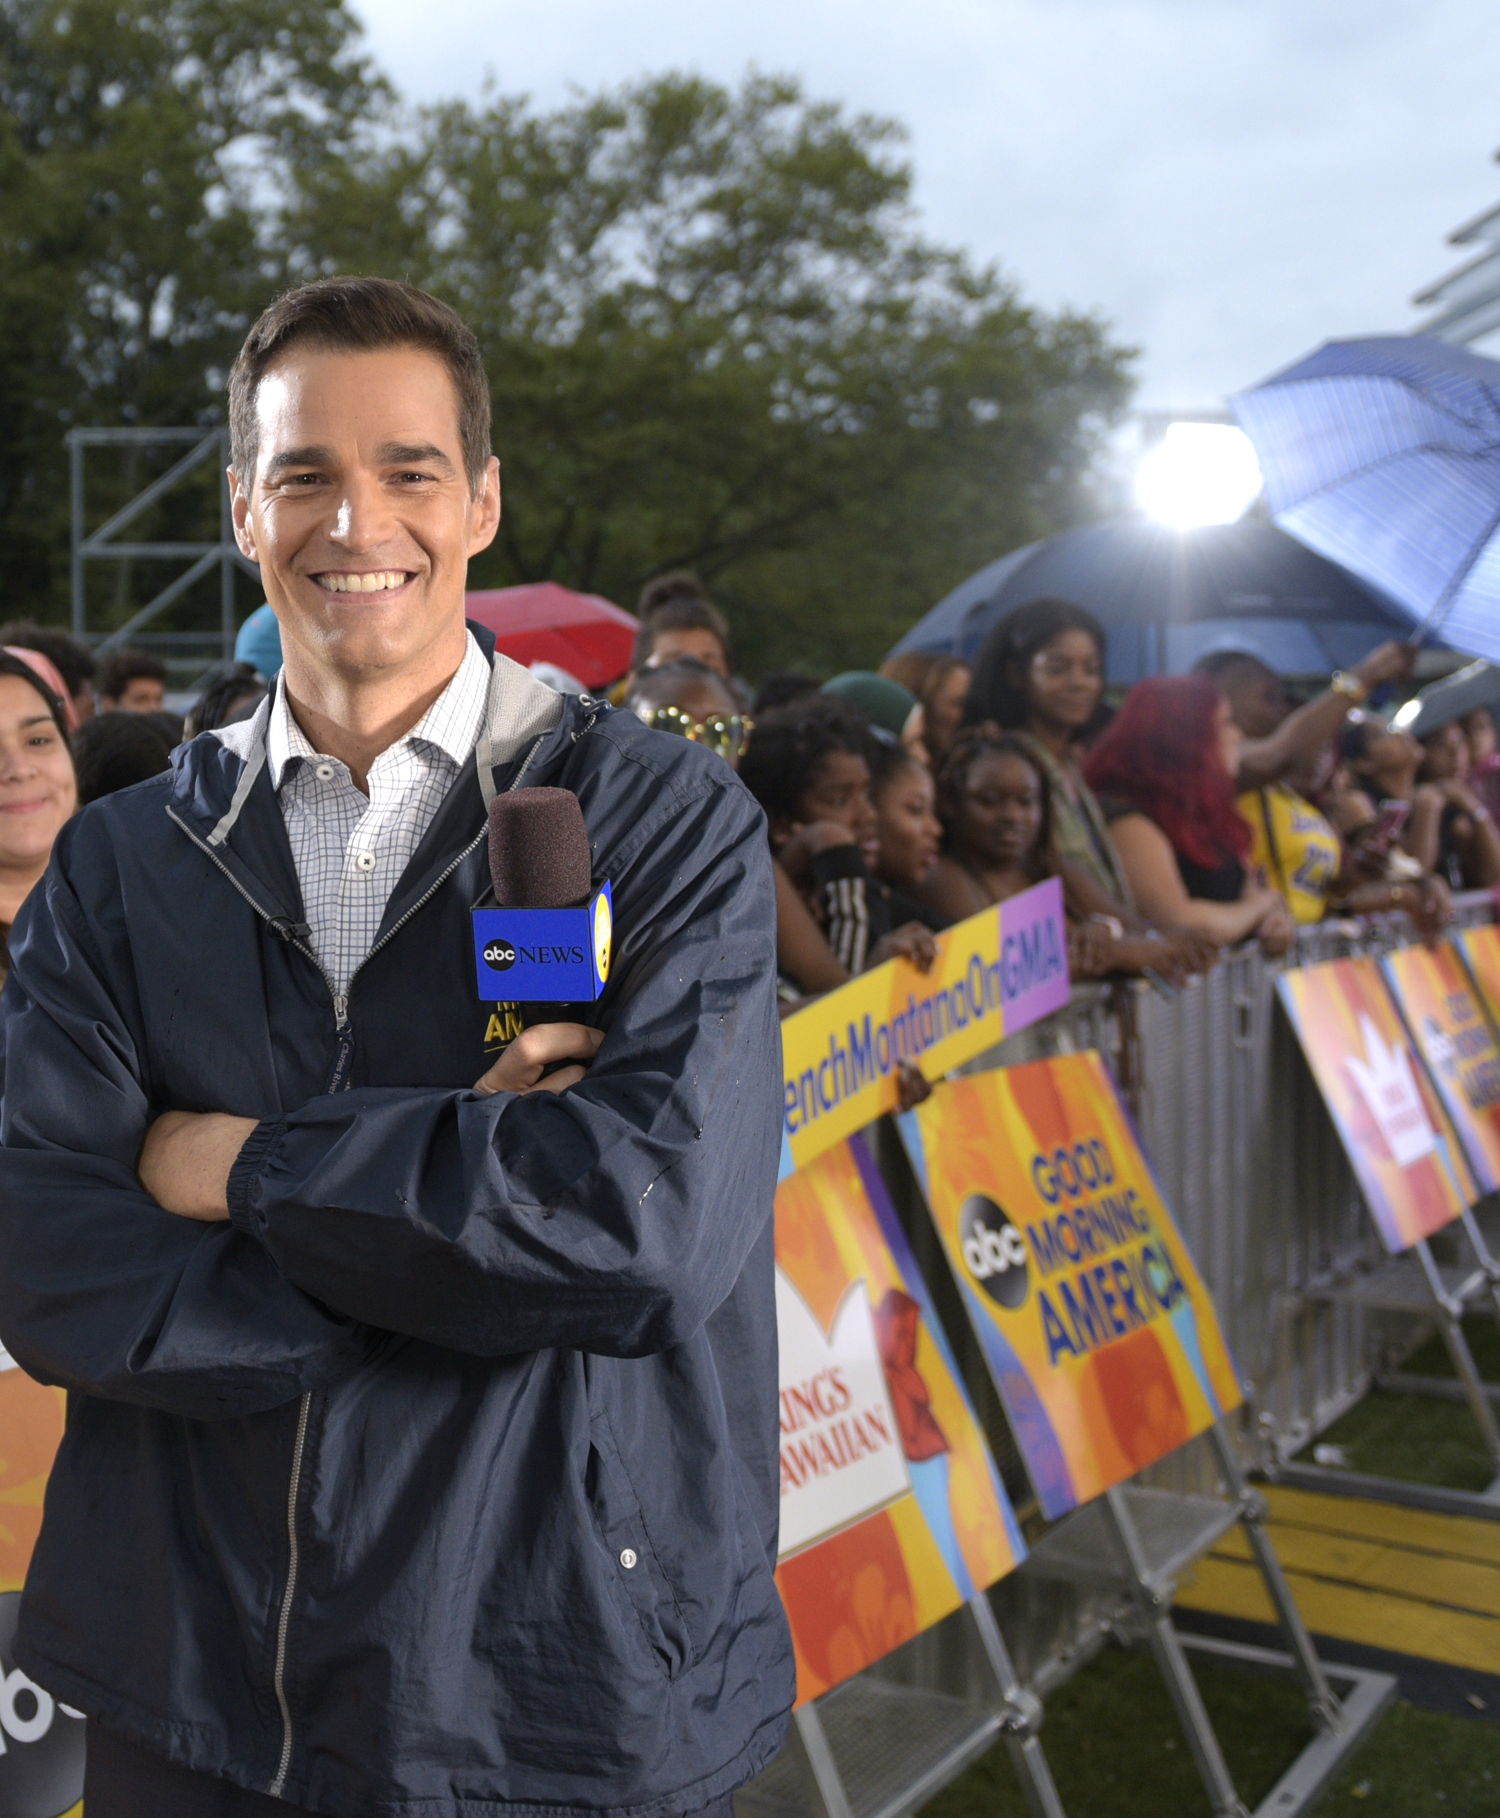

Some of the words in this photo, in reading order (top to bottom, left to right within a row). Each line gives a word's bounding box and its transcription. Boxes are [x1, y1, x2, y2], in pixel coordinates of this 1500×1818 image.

[483, 946, 516, 961] abc
[518, 946, 584, 964] NEWS
[1033, 1138, 1116, 1204] GOOD
[963, 1217, 1027, 1280] abc
[1026, 1188, 1149, 1276] MORNING
[1038, 1241, 1186, 1367] AMERICA
